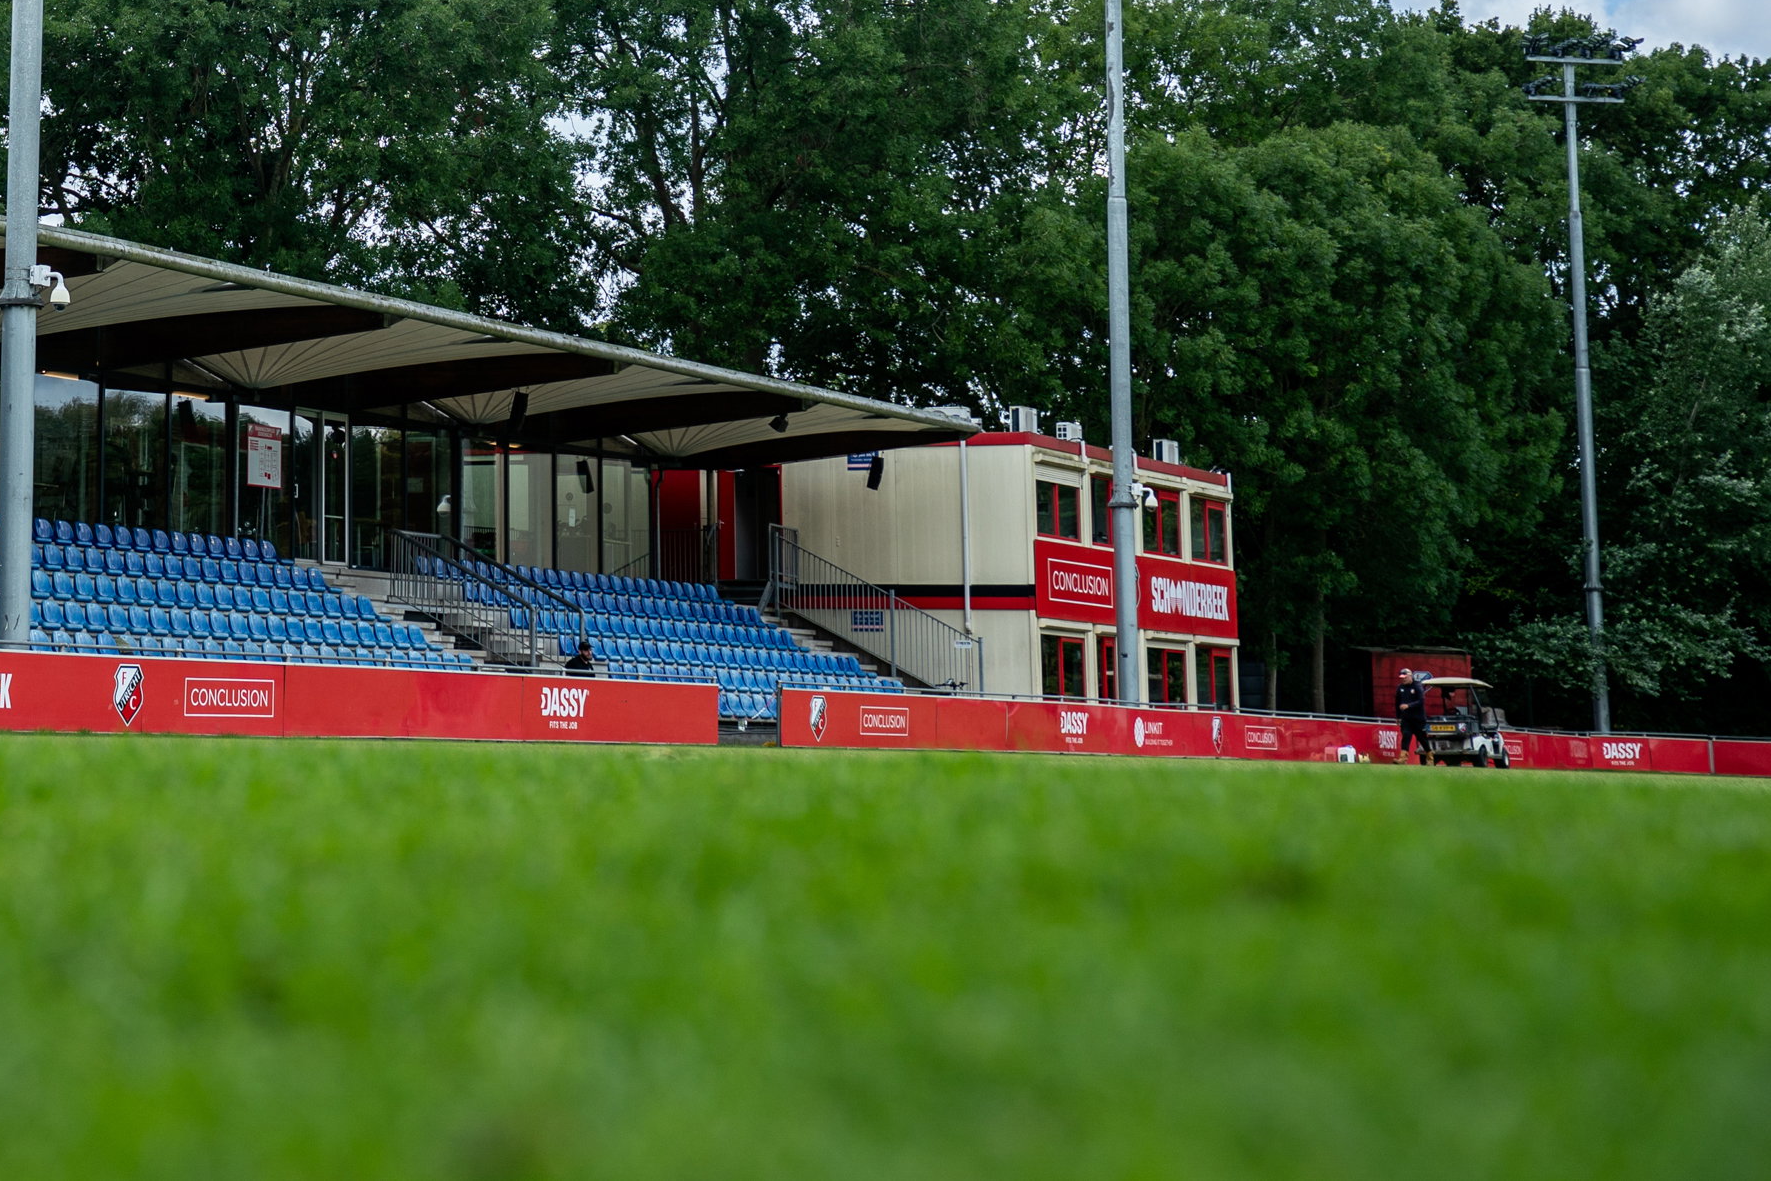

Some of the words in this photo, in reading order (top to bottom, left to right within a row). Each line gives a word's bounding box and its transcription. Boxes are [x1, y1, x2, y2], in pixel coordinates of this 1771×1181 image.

[1052, 570, 1109, 597] CONCLUSION
[121, 671, 127, 686] F
[118, 670, 141, 711] UTRECHT
[190, 688, 269, 707] CONCLUSION
[129, 695, 137, 710] C
[549, 720, 559, 730] FITS
[863, 714, 906, 728] CONCLUSION
[1144, 721, 1164, 734] LINKIT
[1247, 731, 1276, 744] CONCLUSION
[1379, 730, 1398, 750] DASSY
[1602, 742, 1641, 759] DASSY
